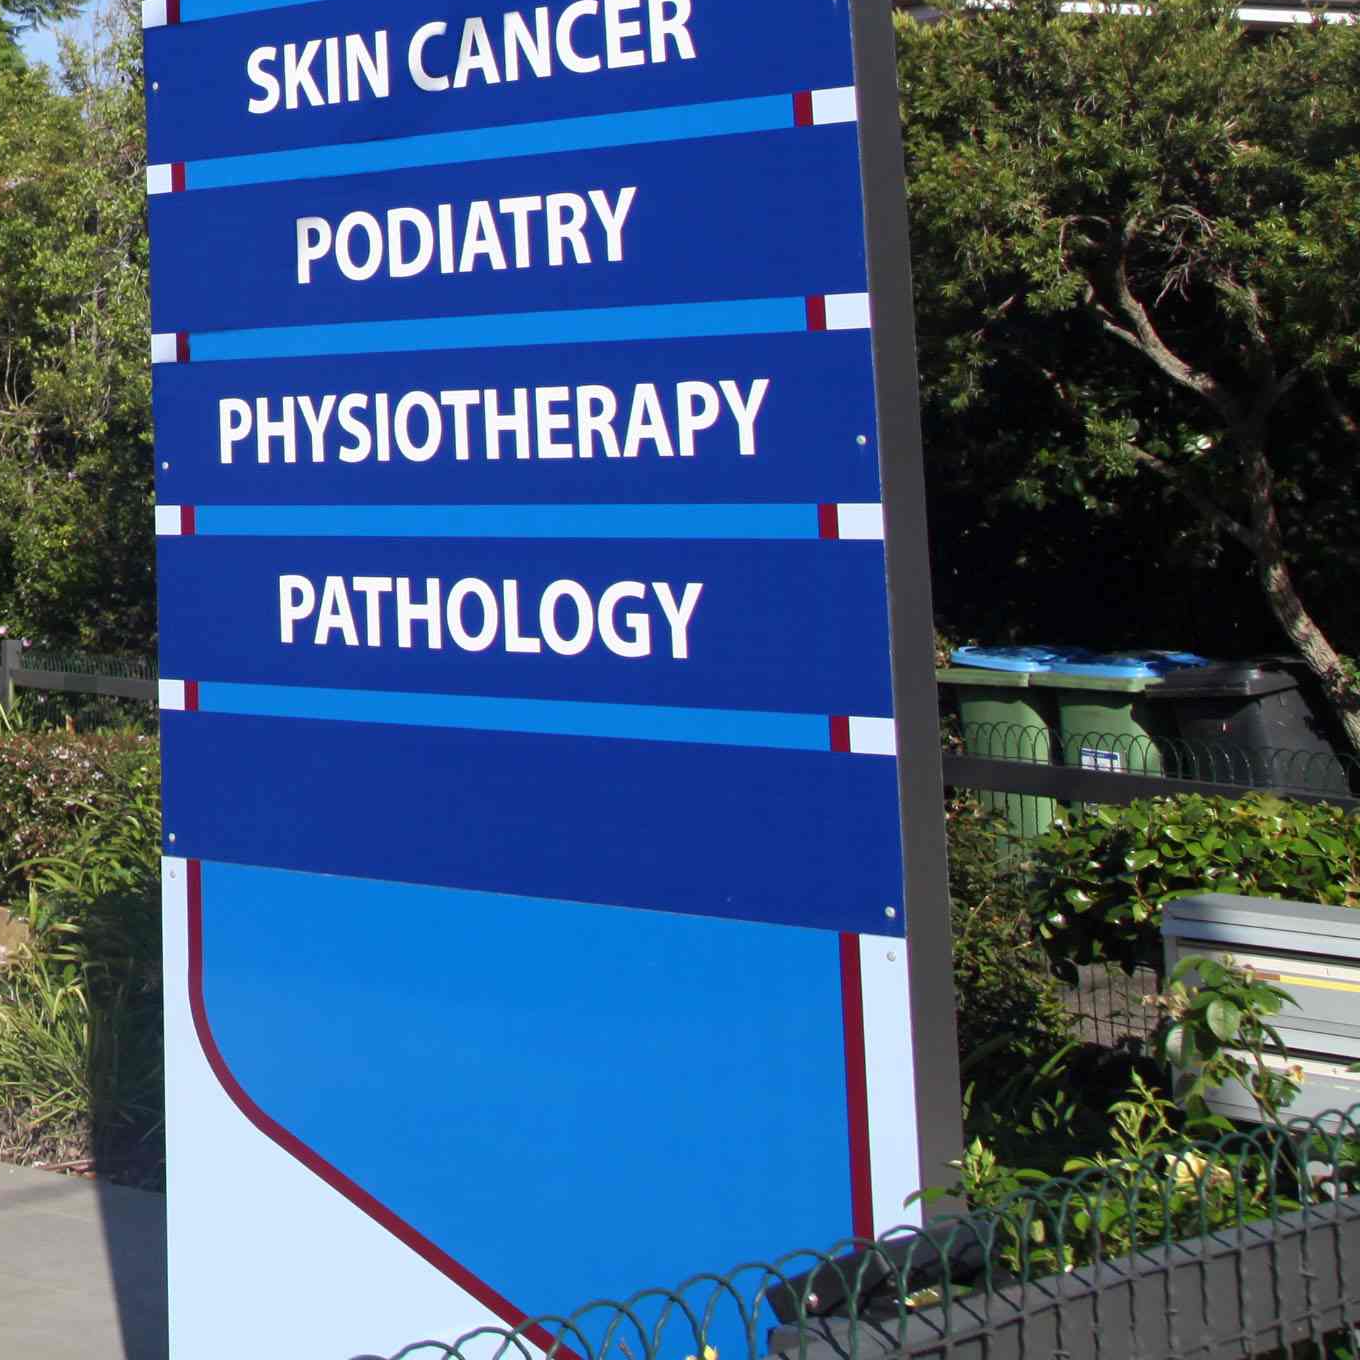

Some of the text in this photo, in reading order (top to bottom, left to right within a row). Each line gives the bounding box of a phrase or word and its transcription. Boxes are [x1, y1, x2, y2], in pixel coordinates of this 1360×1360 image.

[246, 28, 391, 115] SKIN
[295, 185, 638, 285] PODIATRY
[218, 377, 771, 465] PHYSIOTHERAPY
[278, 573, 705, 660] PATHOLOGY
